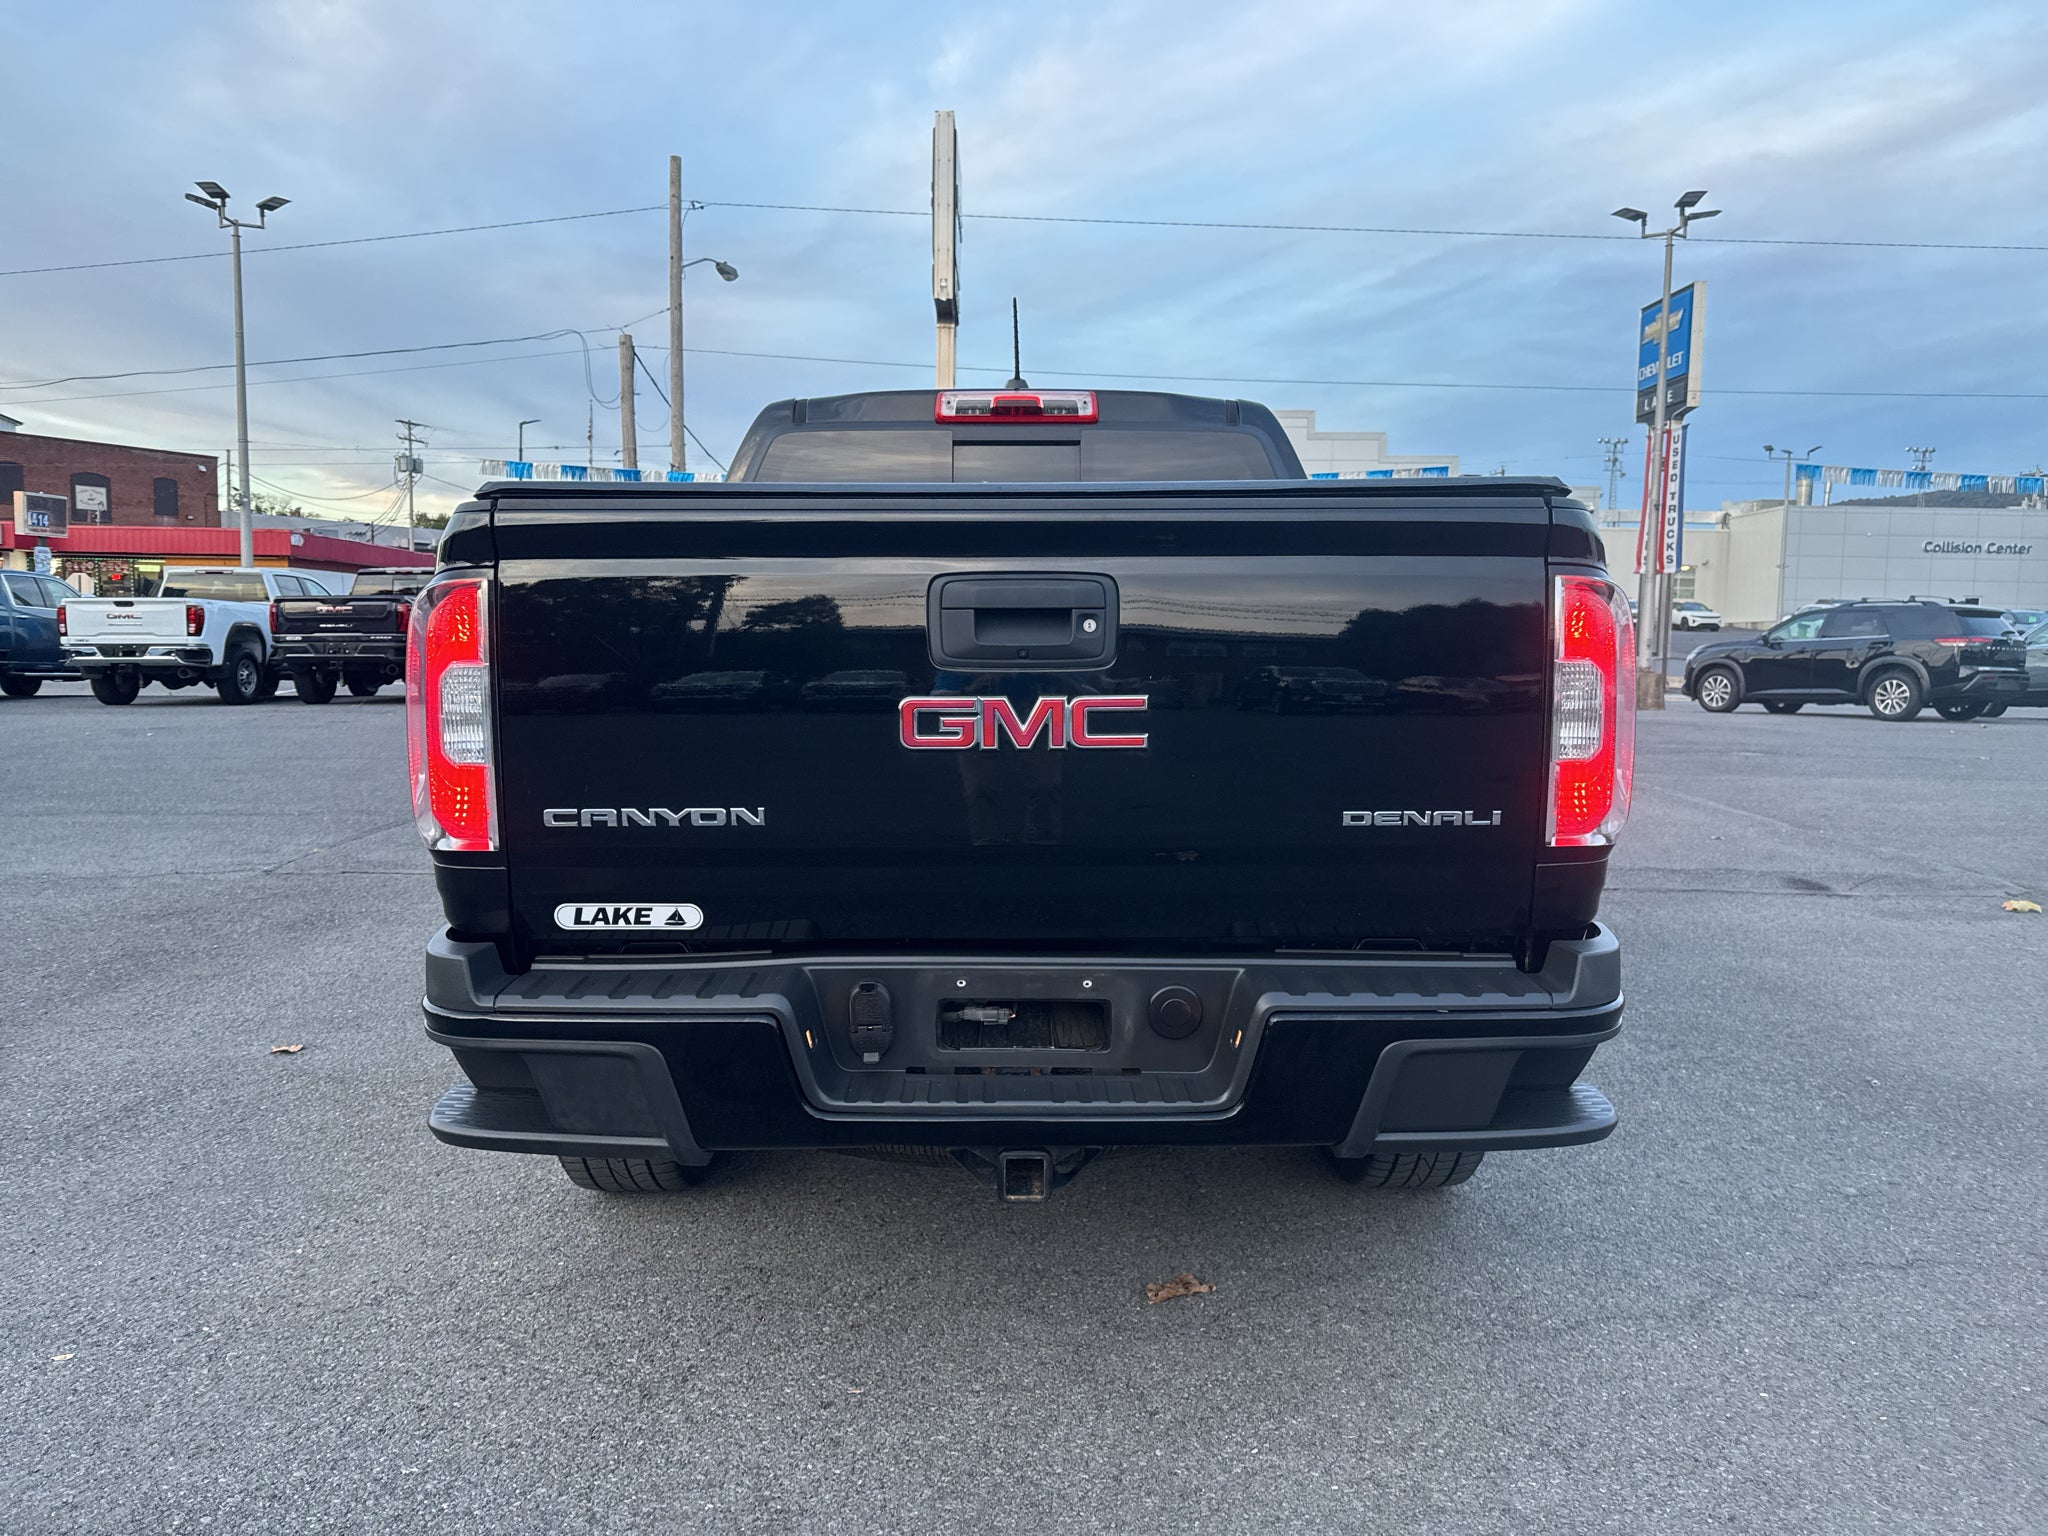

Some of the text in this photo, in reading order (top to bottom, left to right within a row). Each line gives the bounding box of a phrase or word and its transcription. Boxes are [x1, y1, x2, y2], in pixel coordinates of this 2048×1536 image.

[1639, 351, 1684, 381] CHEVLET
[1644, 390, 1673, 410] LAE
[1665, 434, 1680, 564] USED TRUCKS
[1923, 541, 2033, 555] Collision Center
[898, 695, 1149, 750] GMC
[543, 807, 765, 827] CANYON
[1342, 810, 1502, 827] DENALI
[573, 907, 653, 925] LAKE
